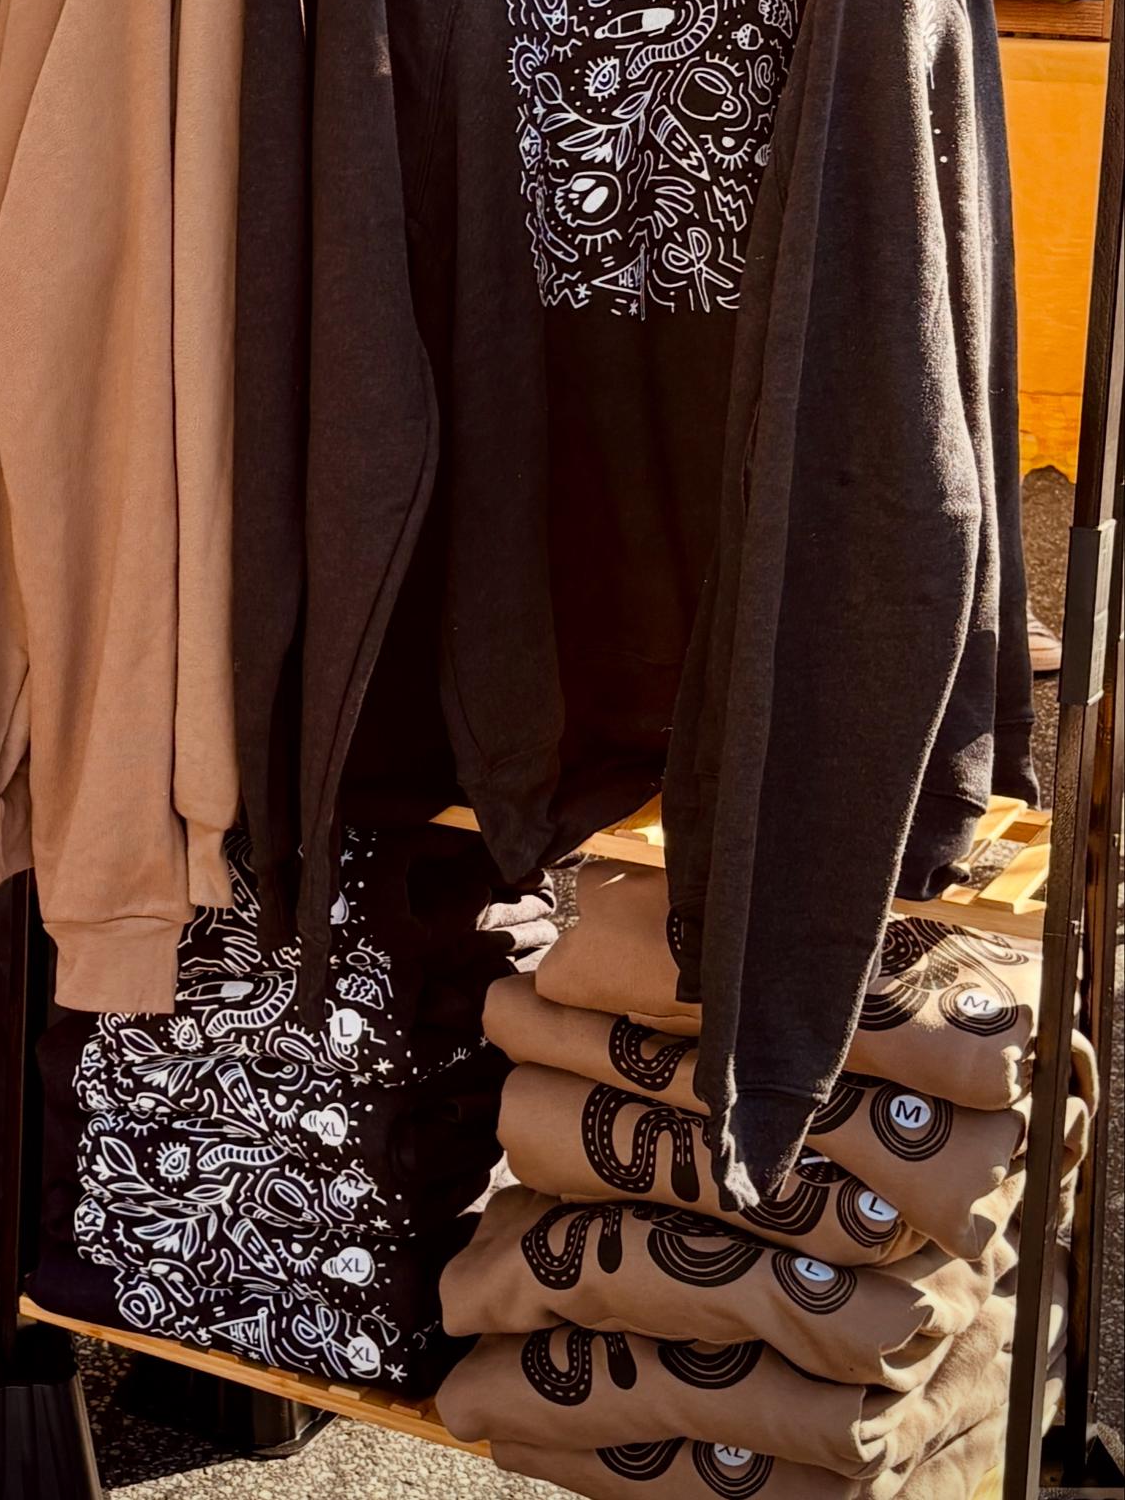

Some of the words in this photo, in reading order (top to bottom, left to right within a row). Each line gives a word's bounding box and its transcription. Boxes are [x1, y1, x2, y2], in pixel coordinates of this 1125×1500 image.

[963, 995, 990, 1011] M
[339, 1017, 352, 1037] L
[895, 1100, 922, 1123] M
[319, 1121, 342, 1137] XL
[869, 1197, 884, 1215] L
[340, 1257, 365, 1273] XL
[805, 1261, 820, 1276] L
[229, 1322, 260, 1345] HEY!
[351, 1345, 376, 1364] XL
